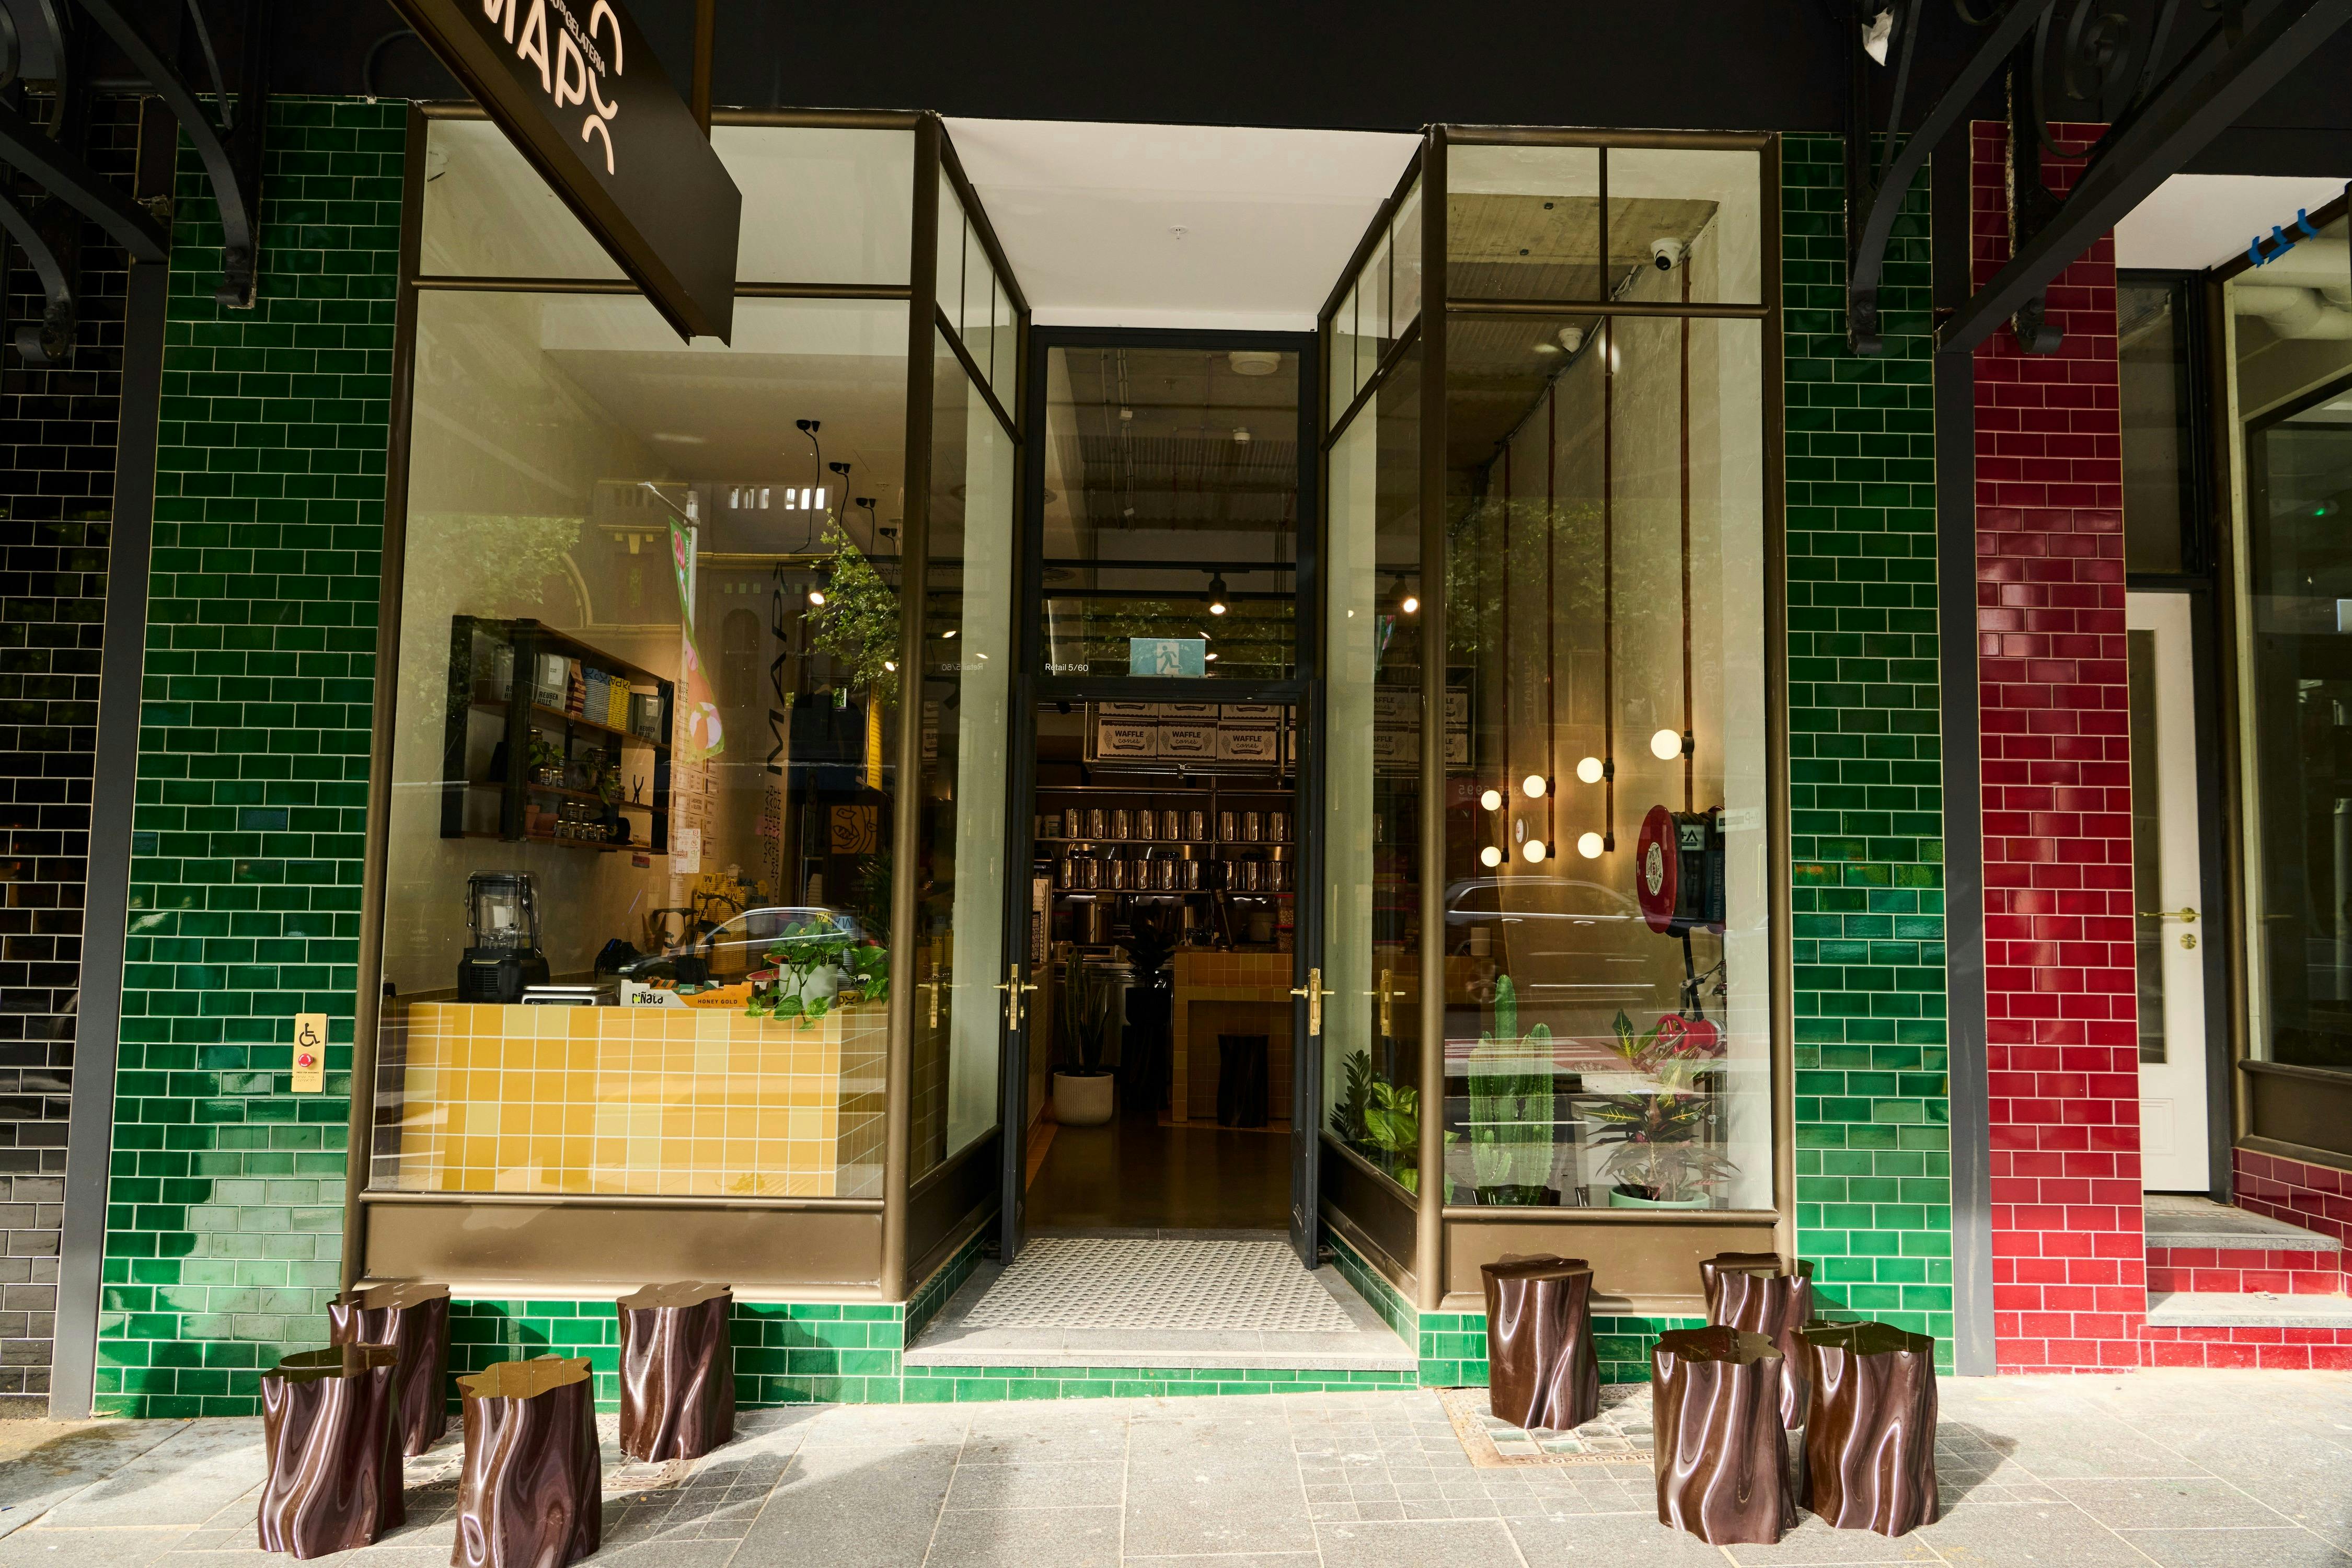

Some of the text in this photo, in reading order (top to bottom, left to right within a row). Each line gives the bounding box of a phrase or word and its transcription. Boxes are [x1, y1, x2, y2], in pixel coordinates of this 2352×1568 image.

[565, 11, 606, 78] GELATERIA
[1045, 663, 1088, 673] Retail 5/60
[539, 691, 559, 700] REUBEN
[537, 698, 552, 707] HILLS
